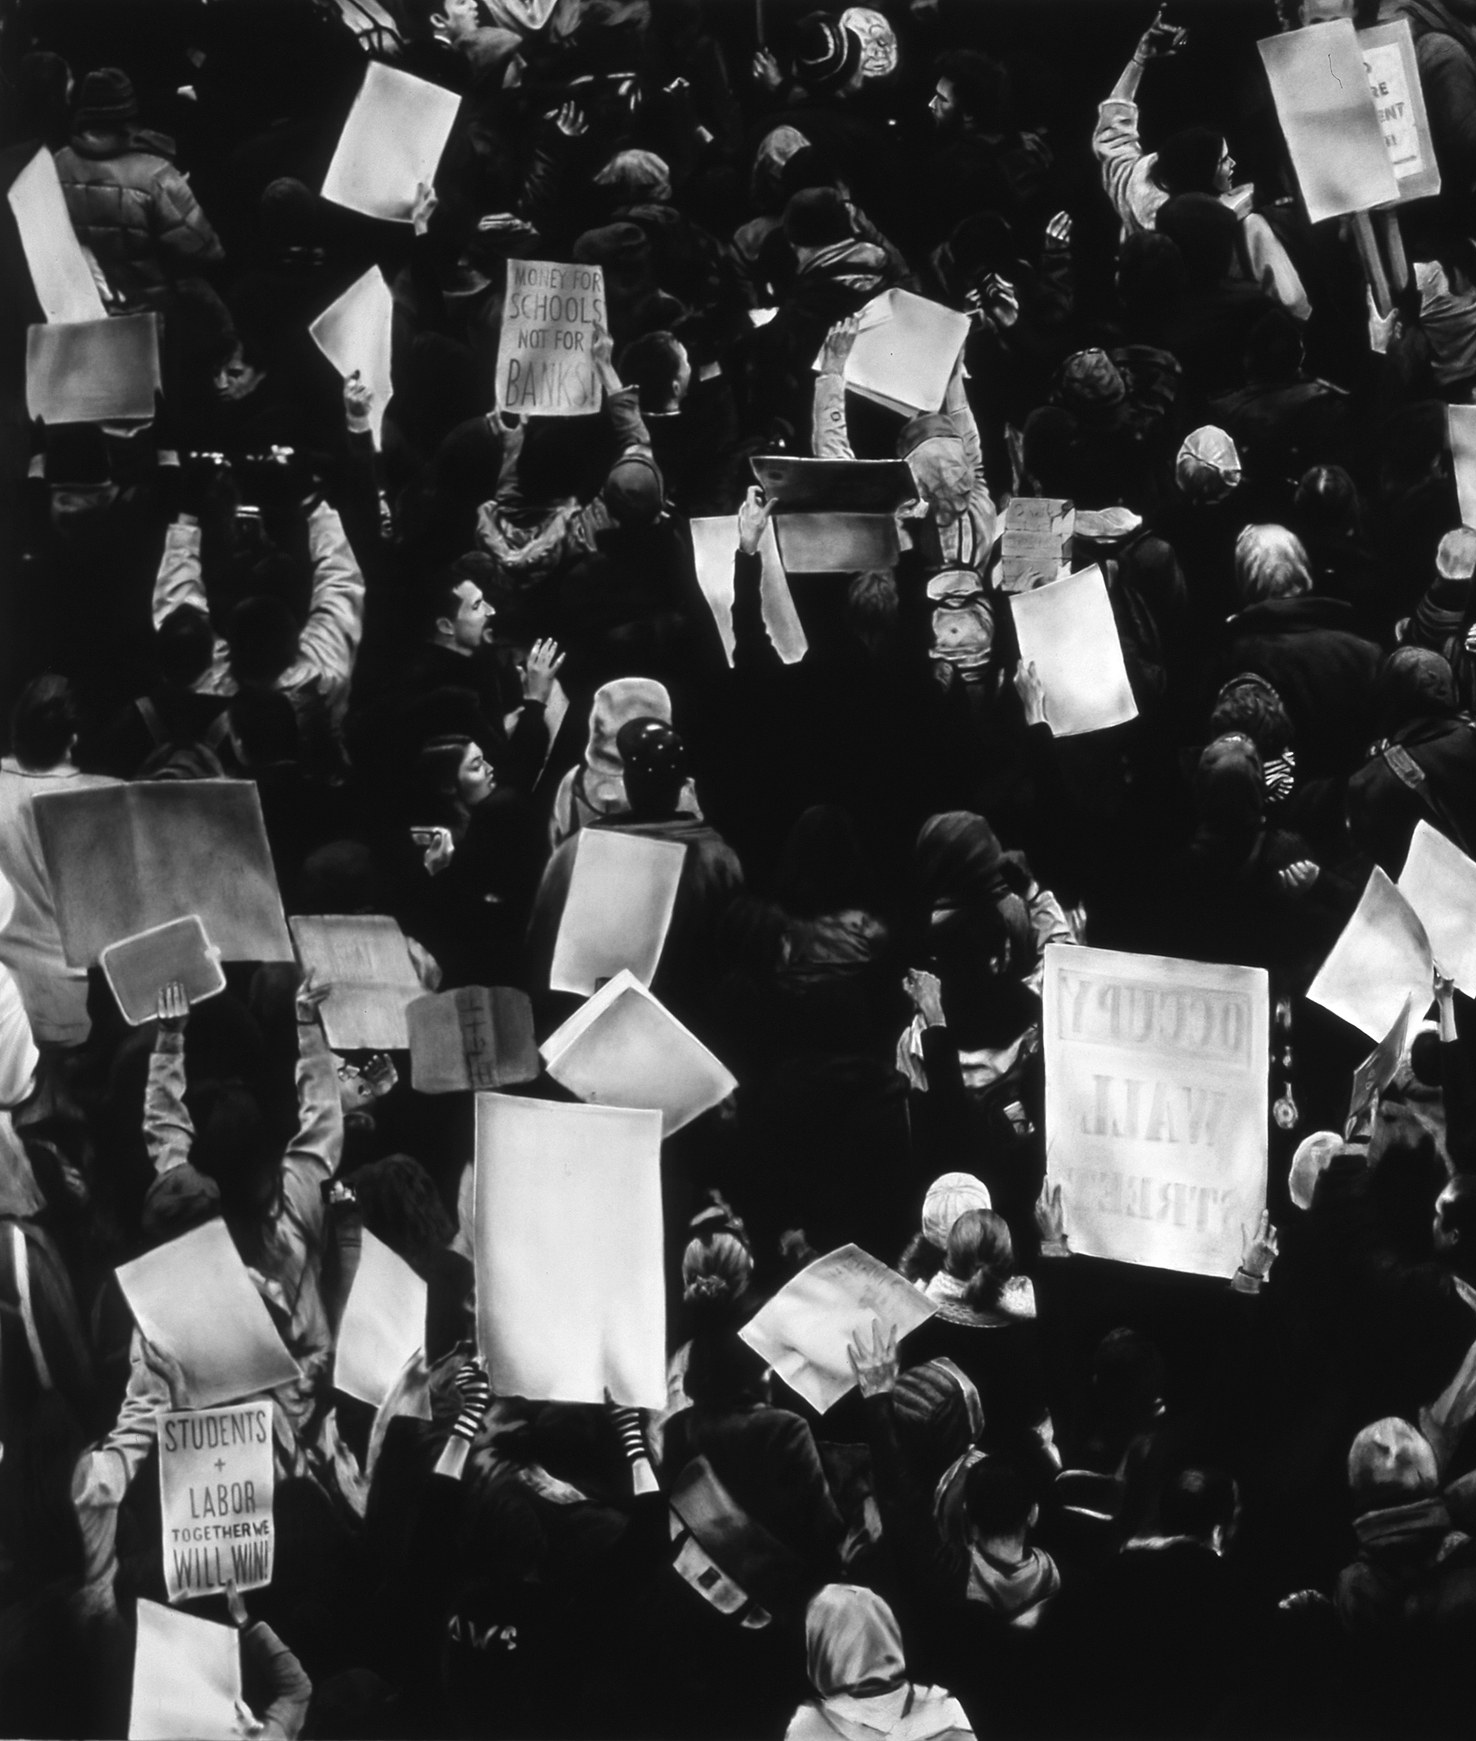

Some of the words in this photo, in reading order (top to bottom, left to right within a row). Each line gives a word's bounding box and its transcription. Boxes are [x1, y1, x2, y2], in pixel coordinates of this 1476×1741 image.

[514, 268, 566, 289] MONEY
[573, 271, 602, 292] FOR
[509, 292, 602, 323] SCHOOLS
[518, 329, 550, 349] NOT
[554, 330, 584, 351] FOR
[505, 358, 595, 407] BANKS!
[165, 1410, 267, 1452] STUDENTS
[189, 1480, 256, 1519] LABOR
[171, 1522, 250, 1543] TOGETHER
[252, 1519, 270, 1536] WE
[173, 1545, 227, 1590] WILL
[231, 1540, 269, 1585] WIN!
